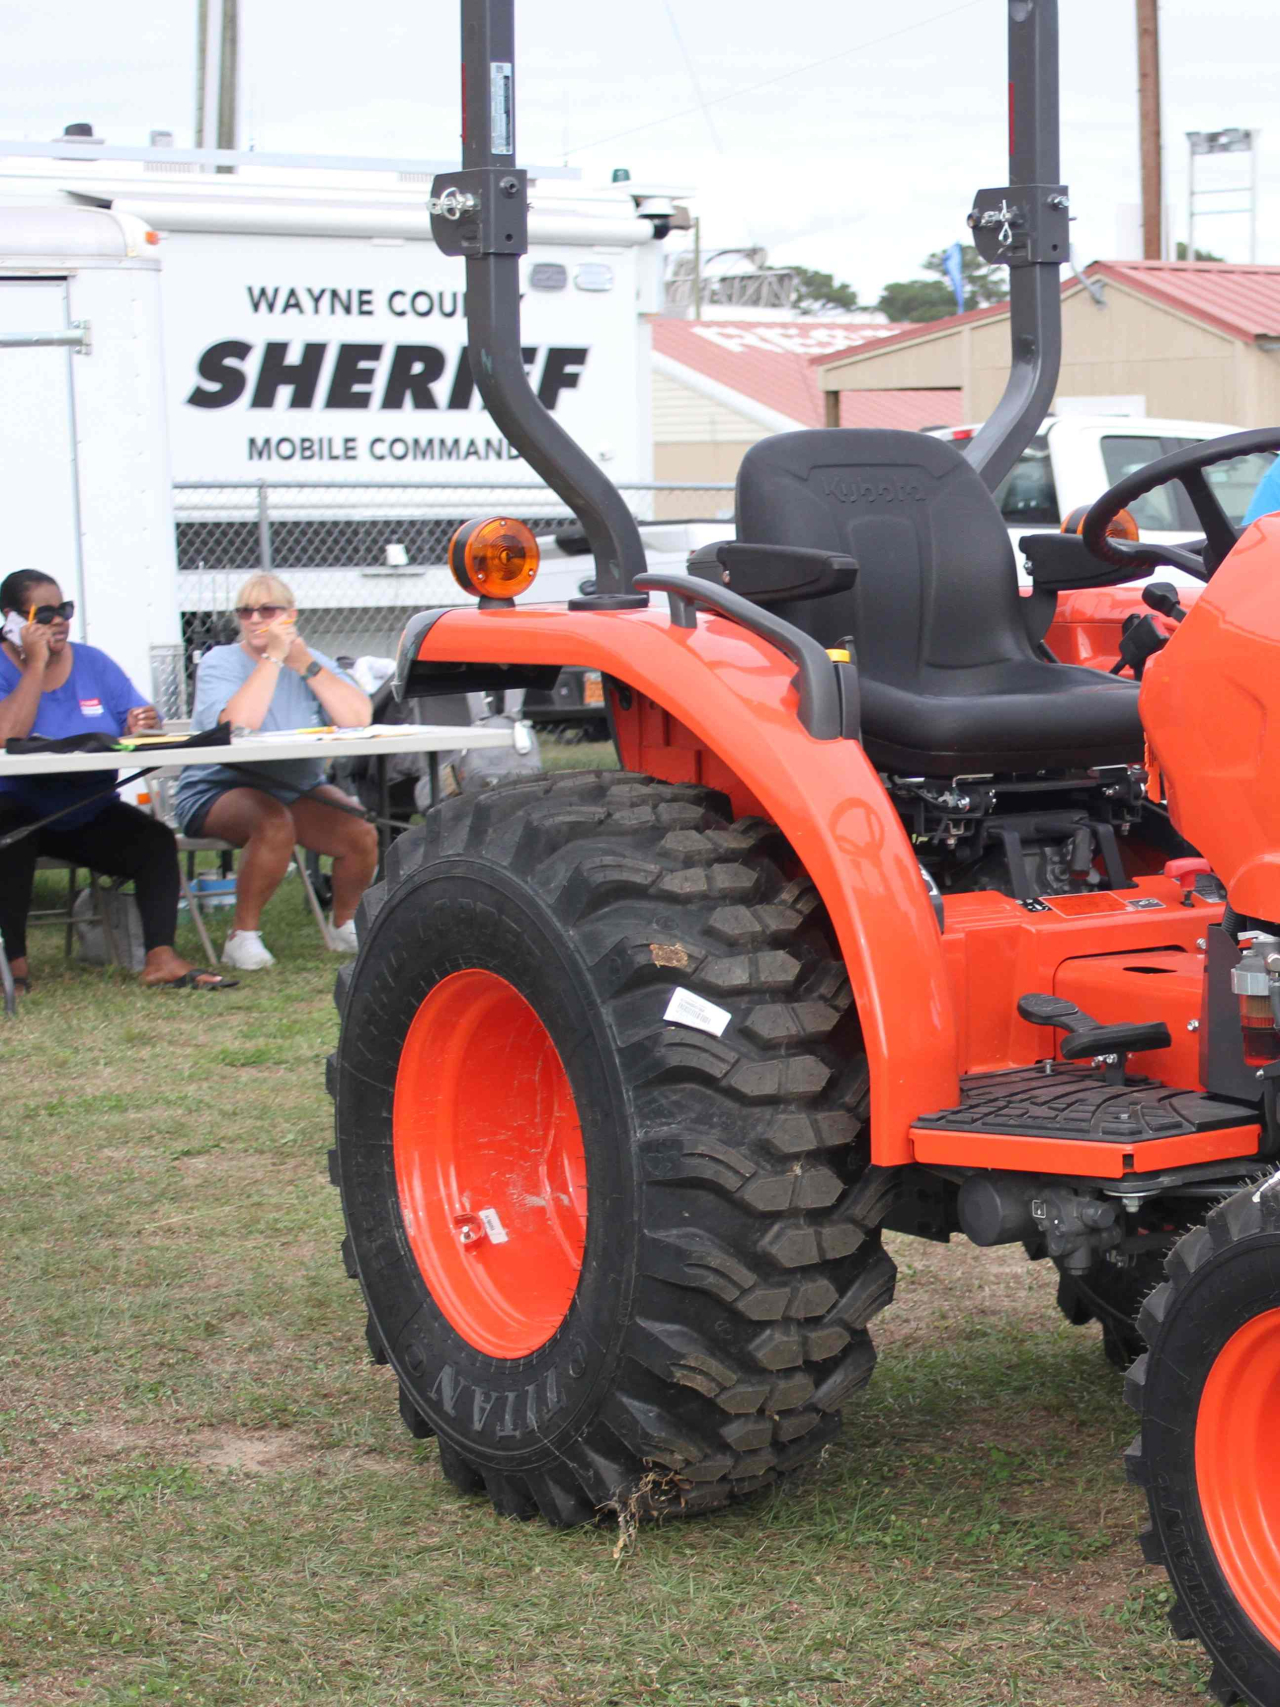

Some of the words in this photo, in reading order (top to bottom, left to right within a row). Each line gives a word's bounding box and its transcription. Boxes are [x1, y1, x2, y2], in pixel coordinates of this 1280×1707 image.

[246, 286, 374, 315] WAYNE
[388, 290, 525, 317] COU
[187, 340, 589, 410] SHERIF
[247, 438, 358, 460] MOBILE
[427, 1363, 567, 1441] TITAN
